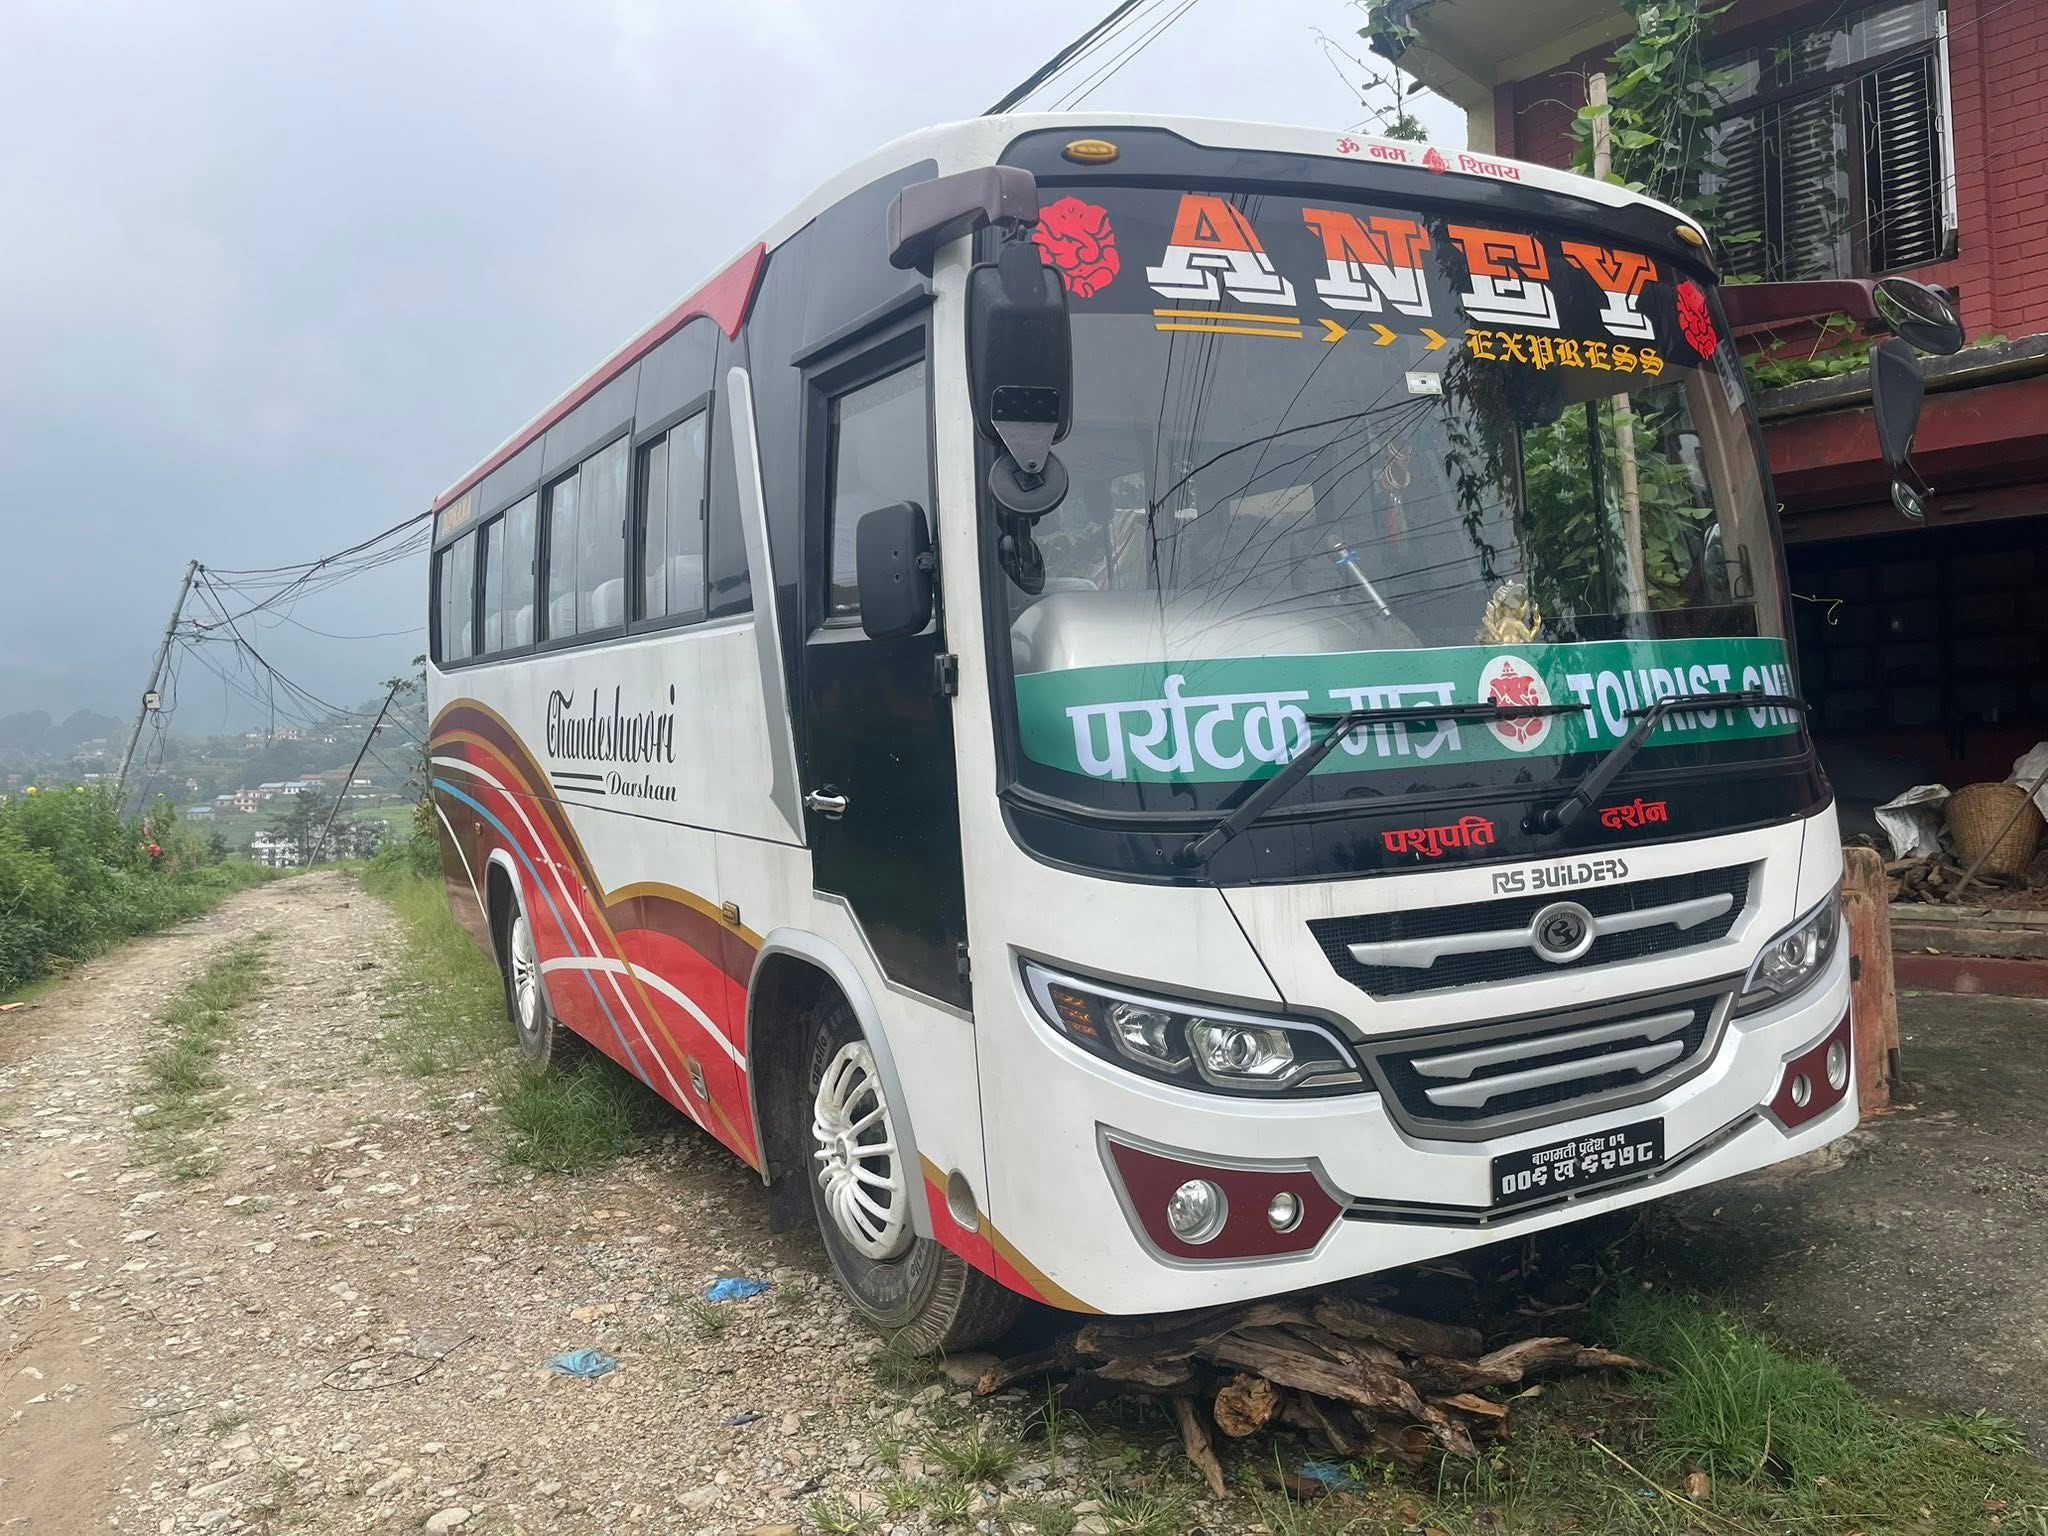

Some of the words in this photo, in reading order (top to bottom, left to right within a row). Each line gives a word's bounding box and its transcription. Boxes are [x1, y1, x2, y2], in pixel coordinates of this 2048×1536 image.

[1458, 153, 1521, 181] शिवाय
[1145, 194, 1659, 340] ANEY
[1464, 328, 1665, 377] EXPRESS
[1065, 674, 1312, 779] पर्यटक
[1566, 664, 1735, 739] TOURIST
[605, 770, 678, 802] Darshan
[1382, 815, 1496, 856] पशुपति
[1600, 798, 1668, 829] दर्शन
[1492, 870, 1525, 894] RS
